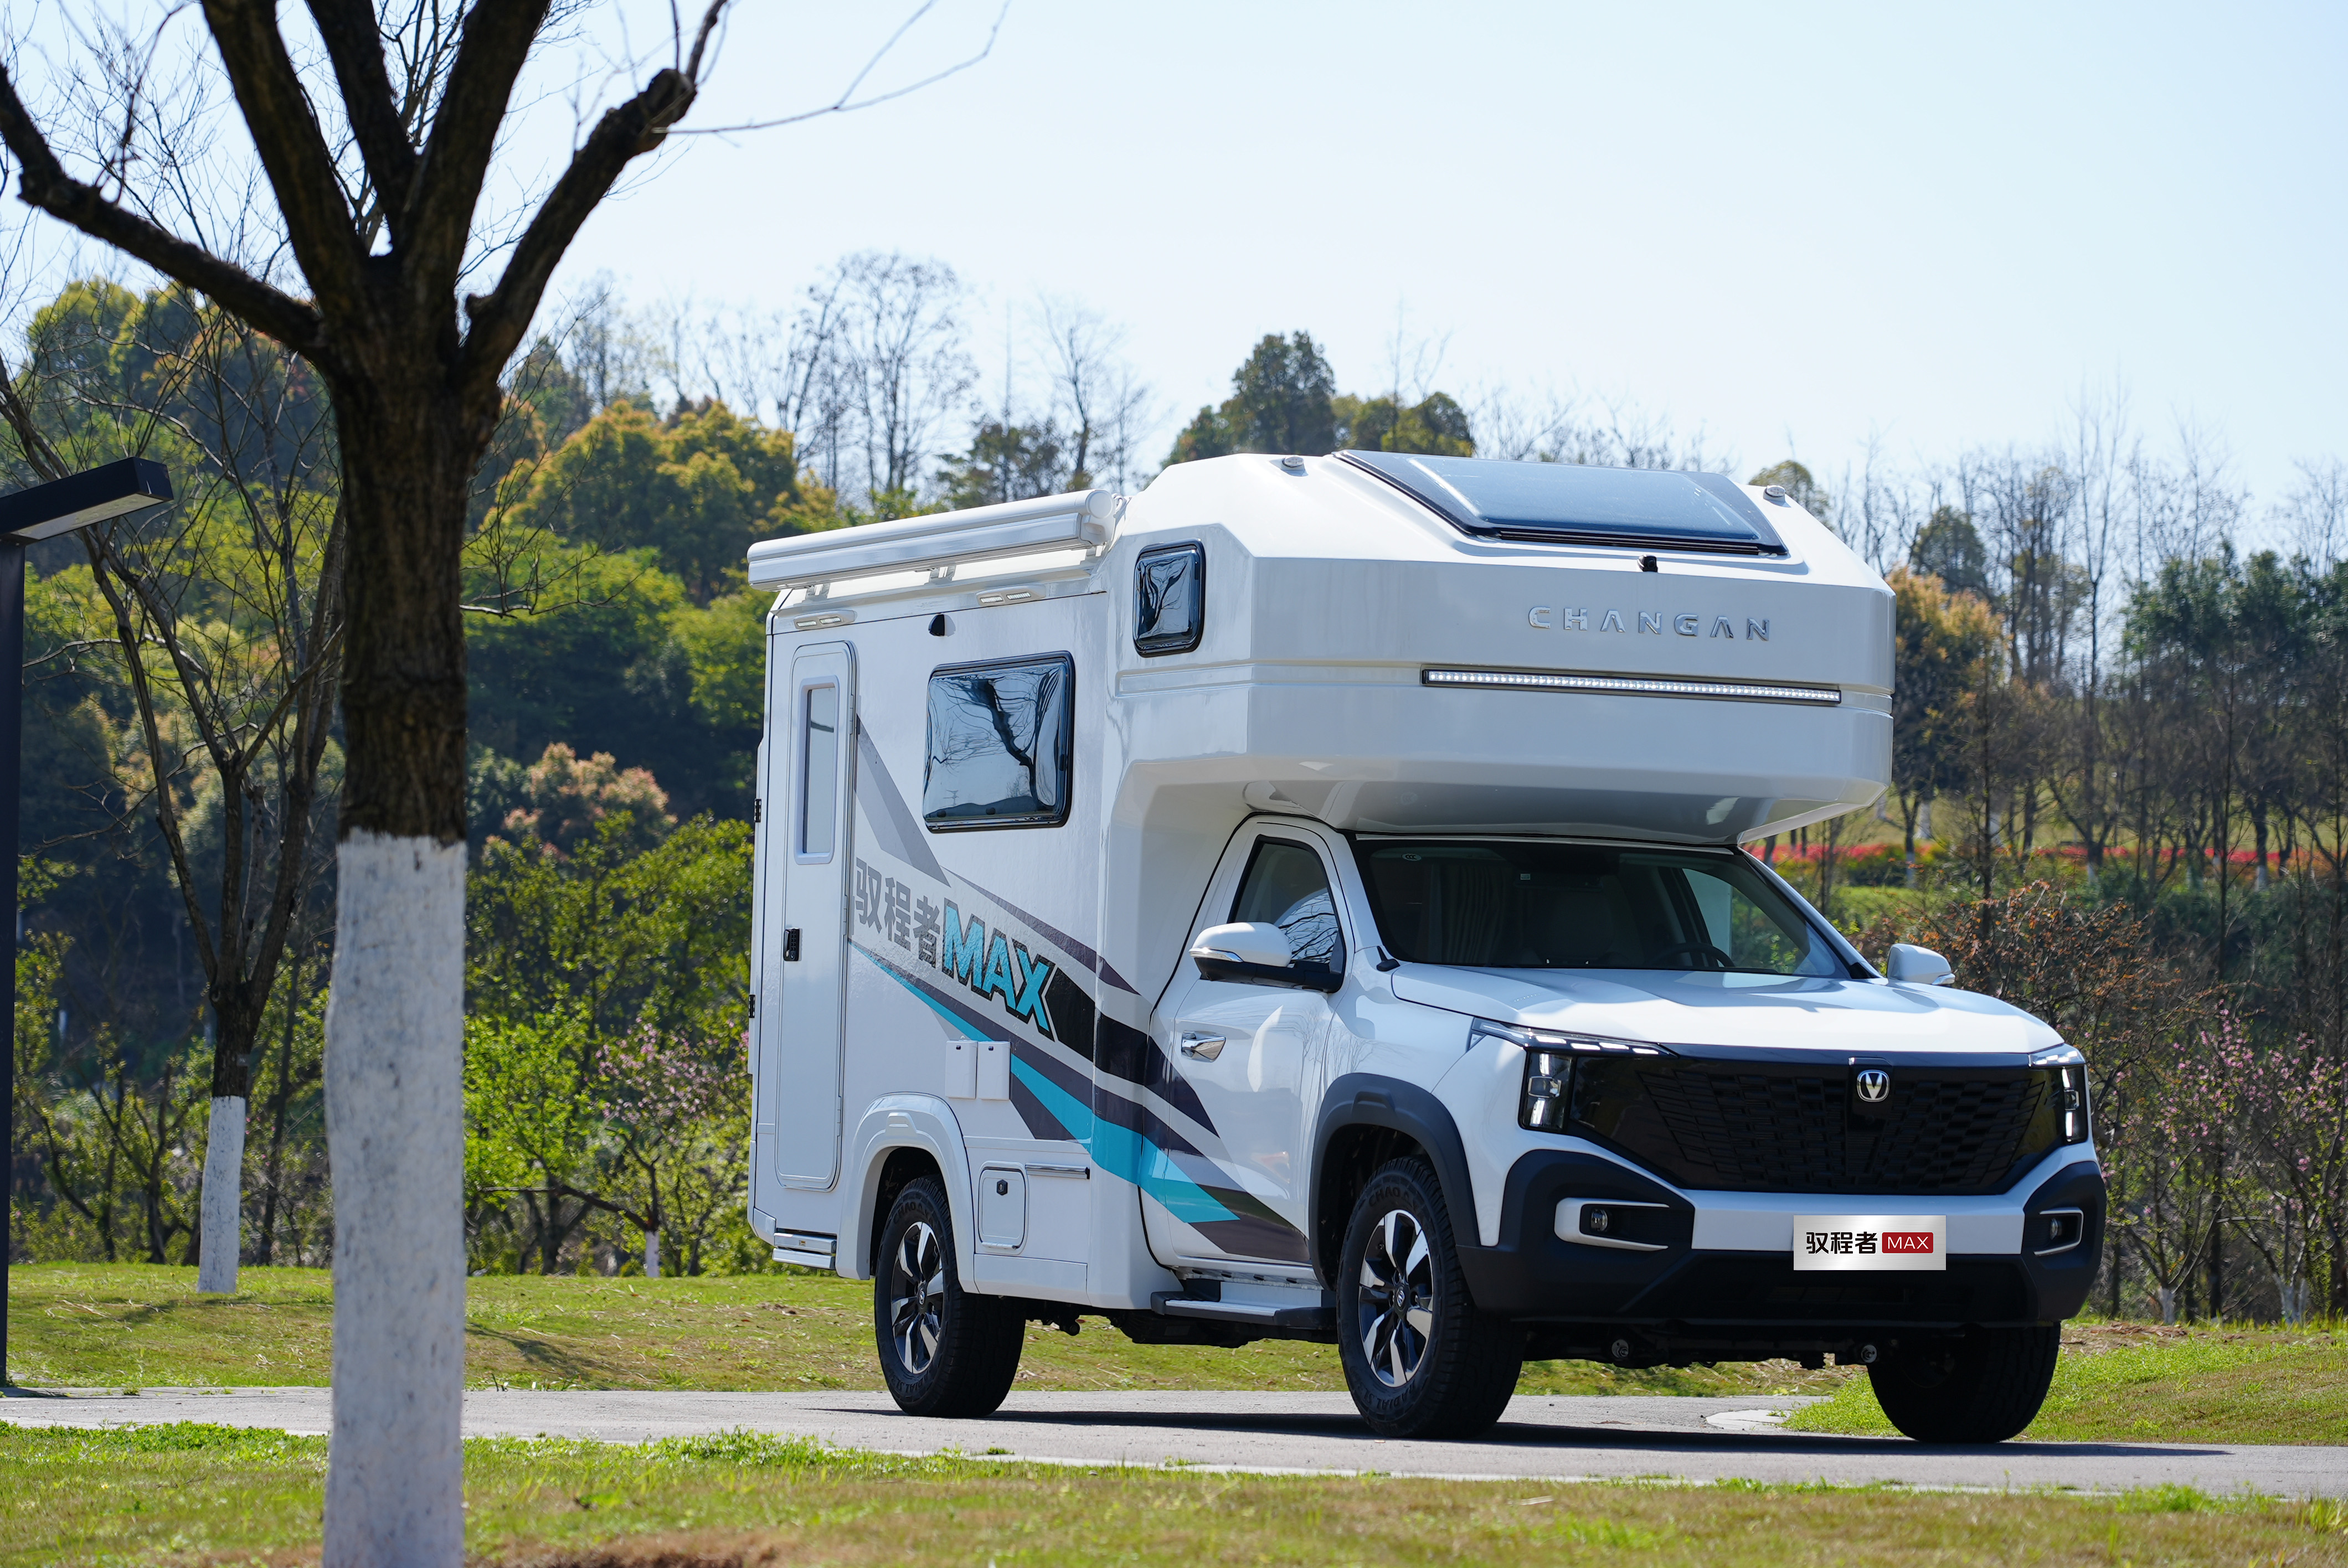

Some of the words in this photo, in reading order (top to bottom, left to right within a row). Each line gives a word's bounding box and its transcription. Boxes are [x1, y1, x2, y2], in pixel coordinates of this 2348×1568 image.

[1528, 605, 1770, 642] CHANGAN
[856, 857, 940, 968] 驭程者
[942, 898, 1056, 1041] MAX
[1806, 1231, 1877, 1254] 驭程者
[1888, 1236, 1929, 1250] MAX
